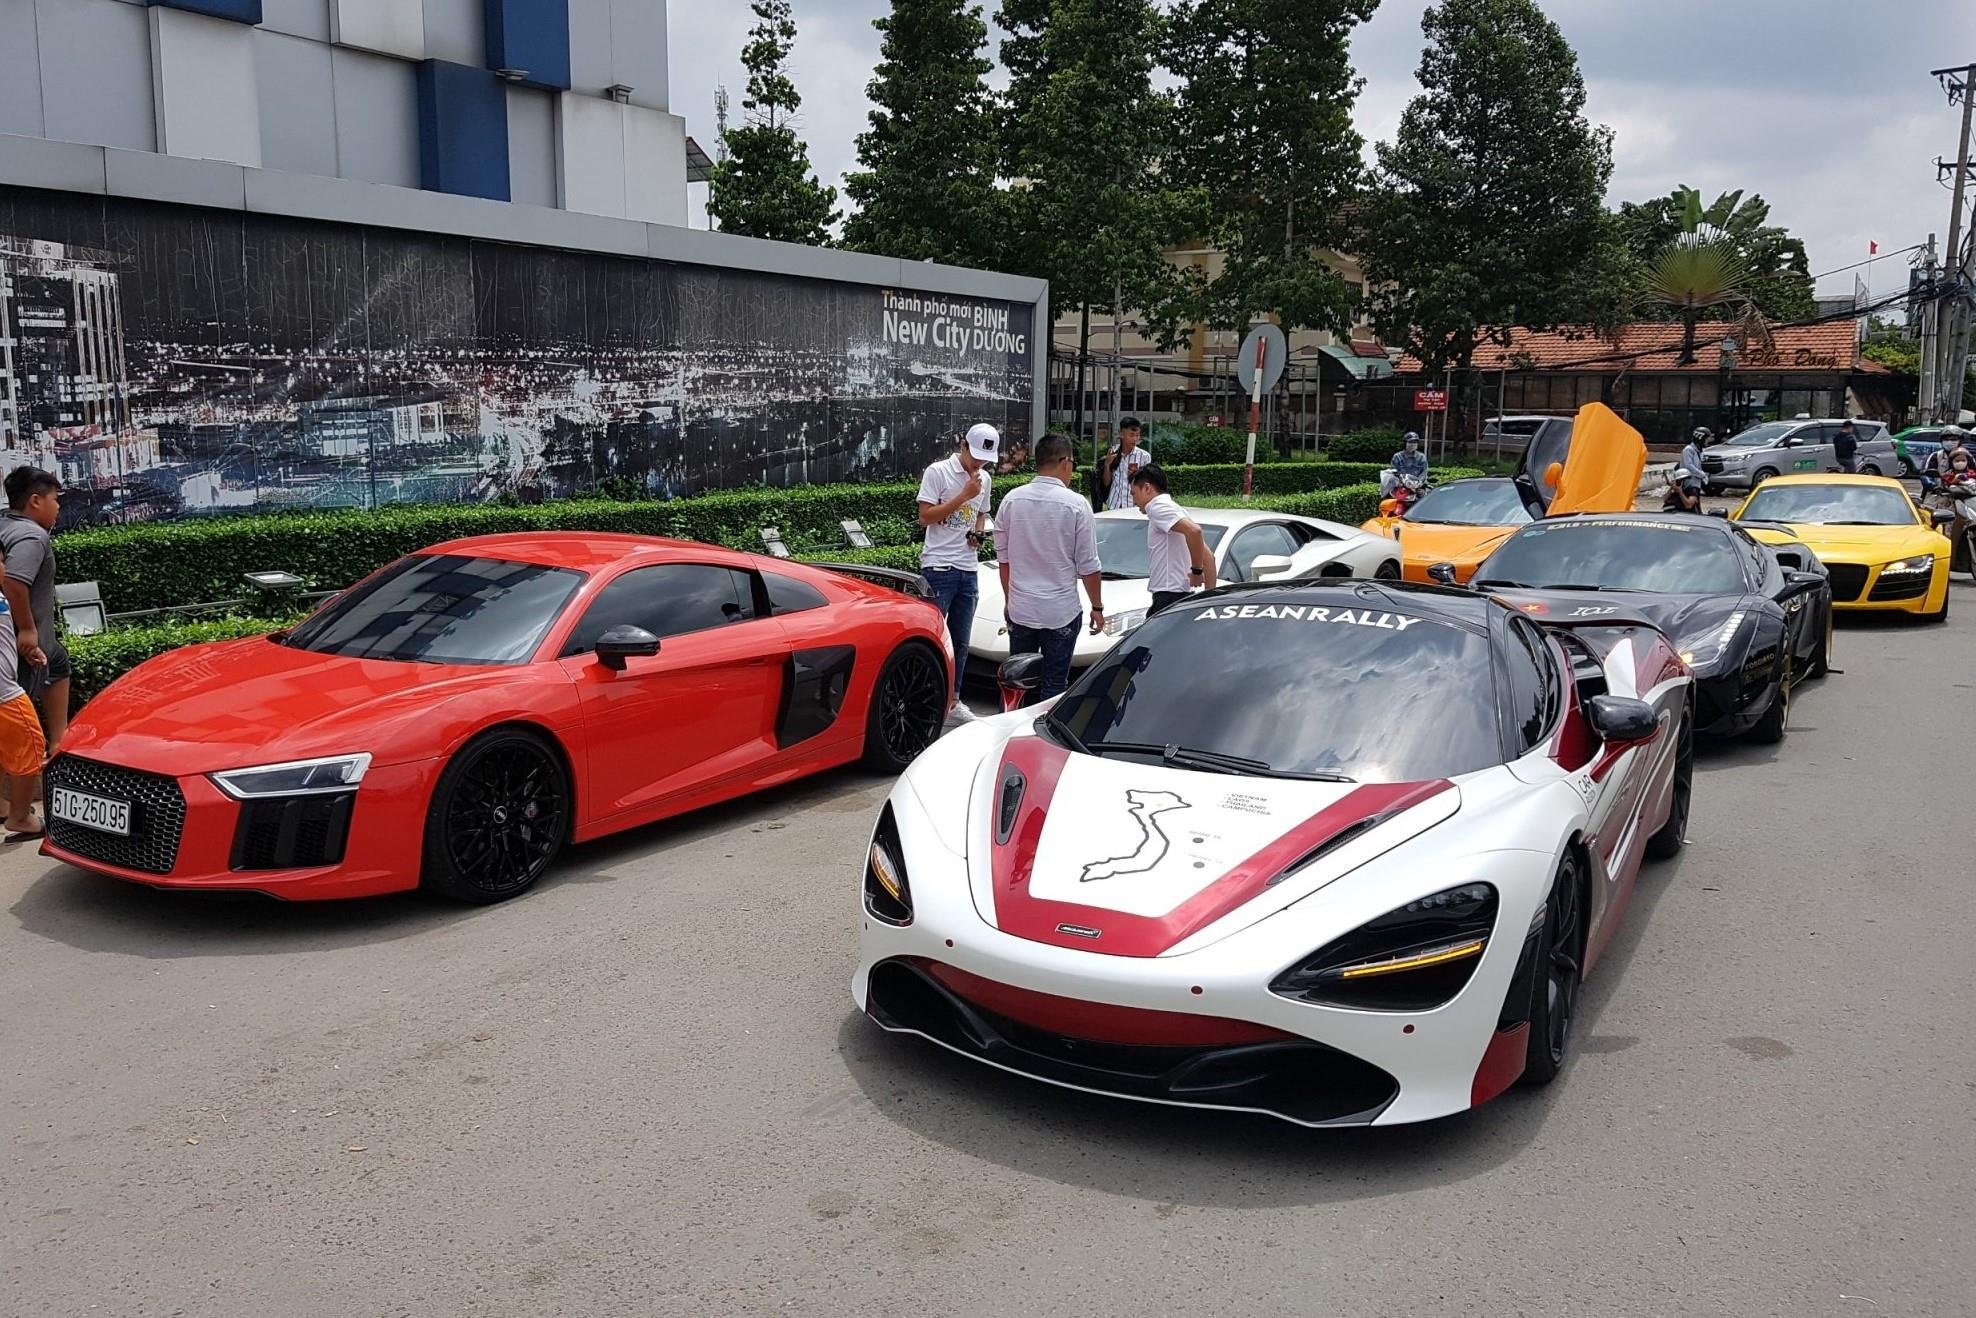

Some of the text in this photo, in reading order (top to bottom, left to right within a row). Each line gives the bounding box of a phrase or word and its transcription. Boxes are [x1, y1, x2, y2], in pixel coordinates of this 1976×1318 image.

[882, 290, 1009, 330] Thành phố mới BÌNH
[883, 310, 1025, 357] New City DƯƠNG
[54, 790, 127, 830] 51G-250.95
